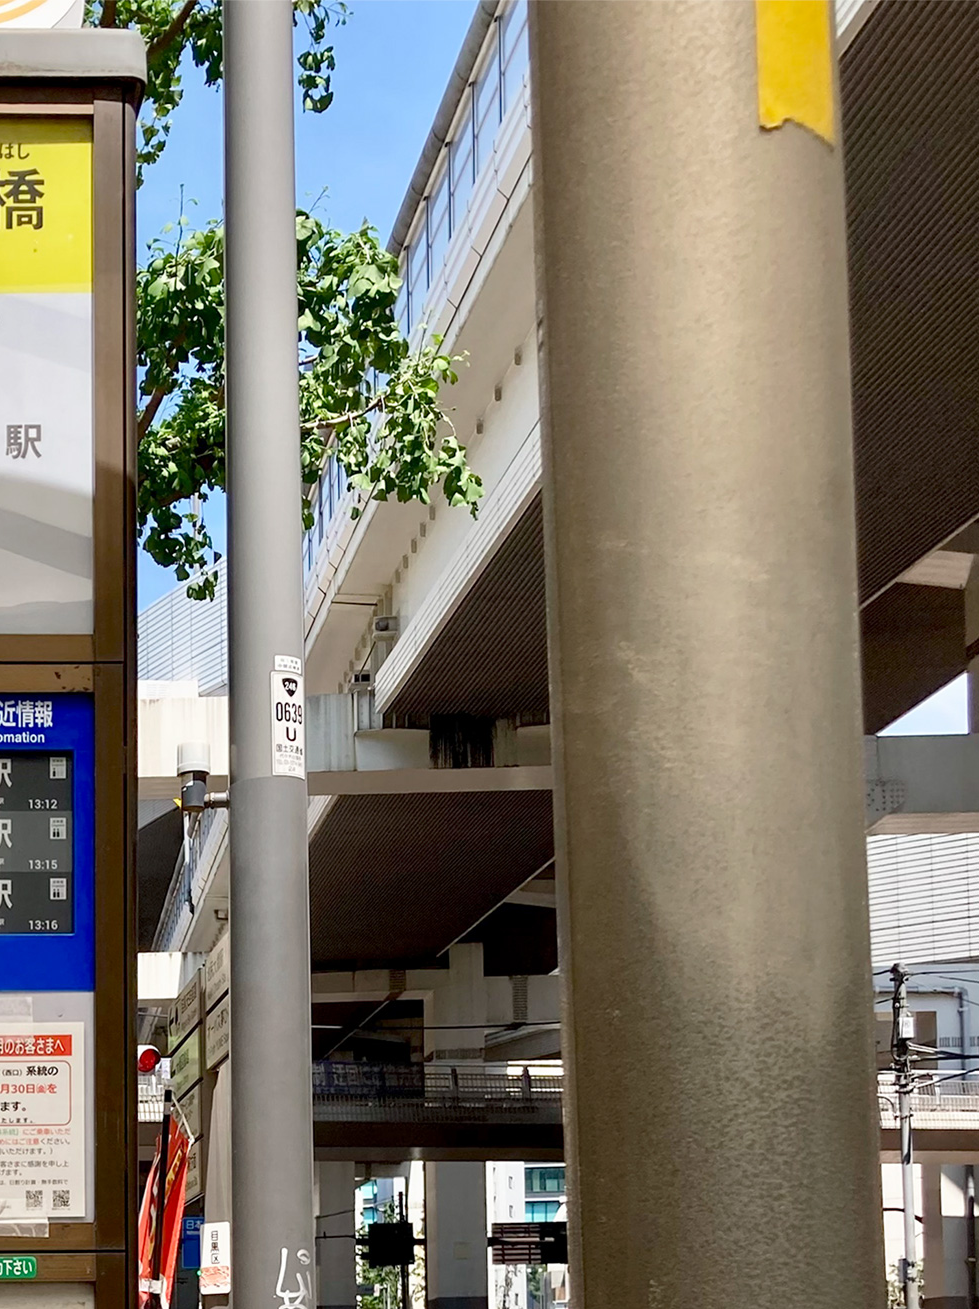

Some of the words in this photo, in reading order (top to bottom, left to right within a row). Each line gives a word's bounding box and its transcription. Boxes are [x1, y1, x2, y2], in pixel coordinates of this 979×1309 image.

[276, 702, 303, 725] 0639
[286, 726, 297, 742] U
[28, 799, 58, 809] 13:12
[28, 860, 58, 870] 13:15
[28, 920, 58, 930] 13:16
[211, 1231, 220, 1264] 目黒区
